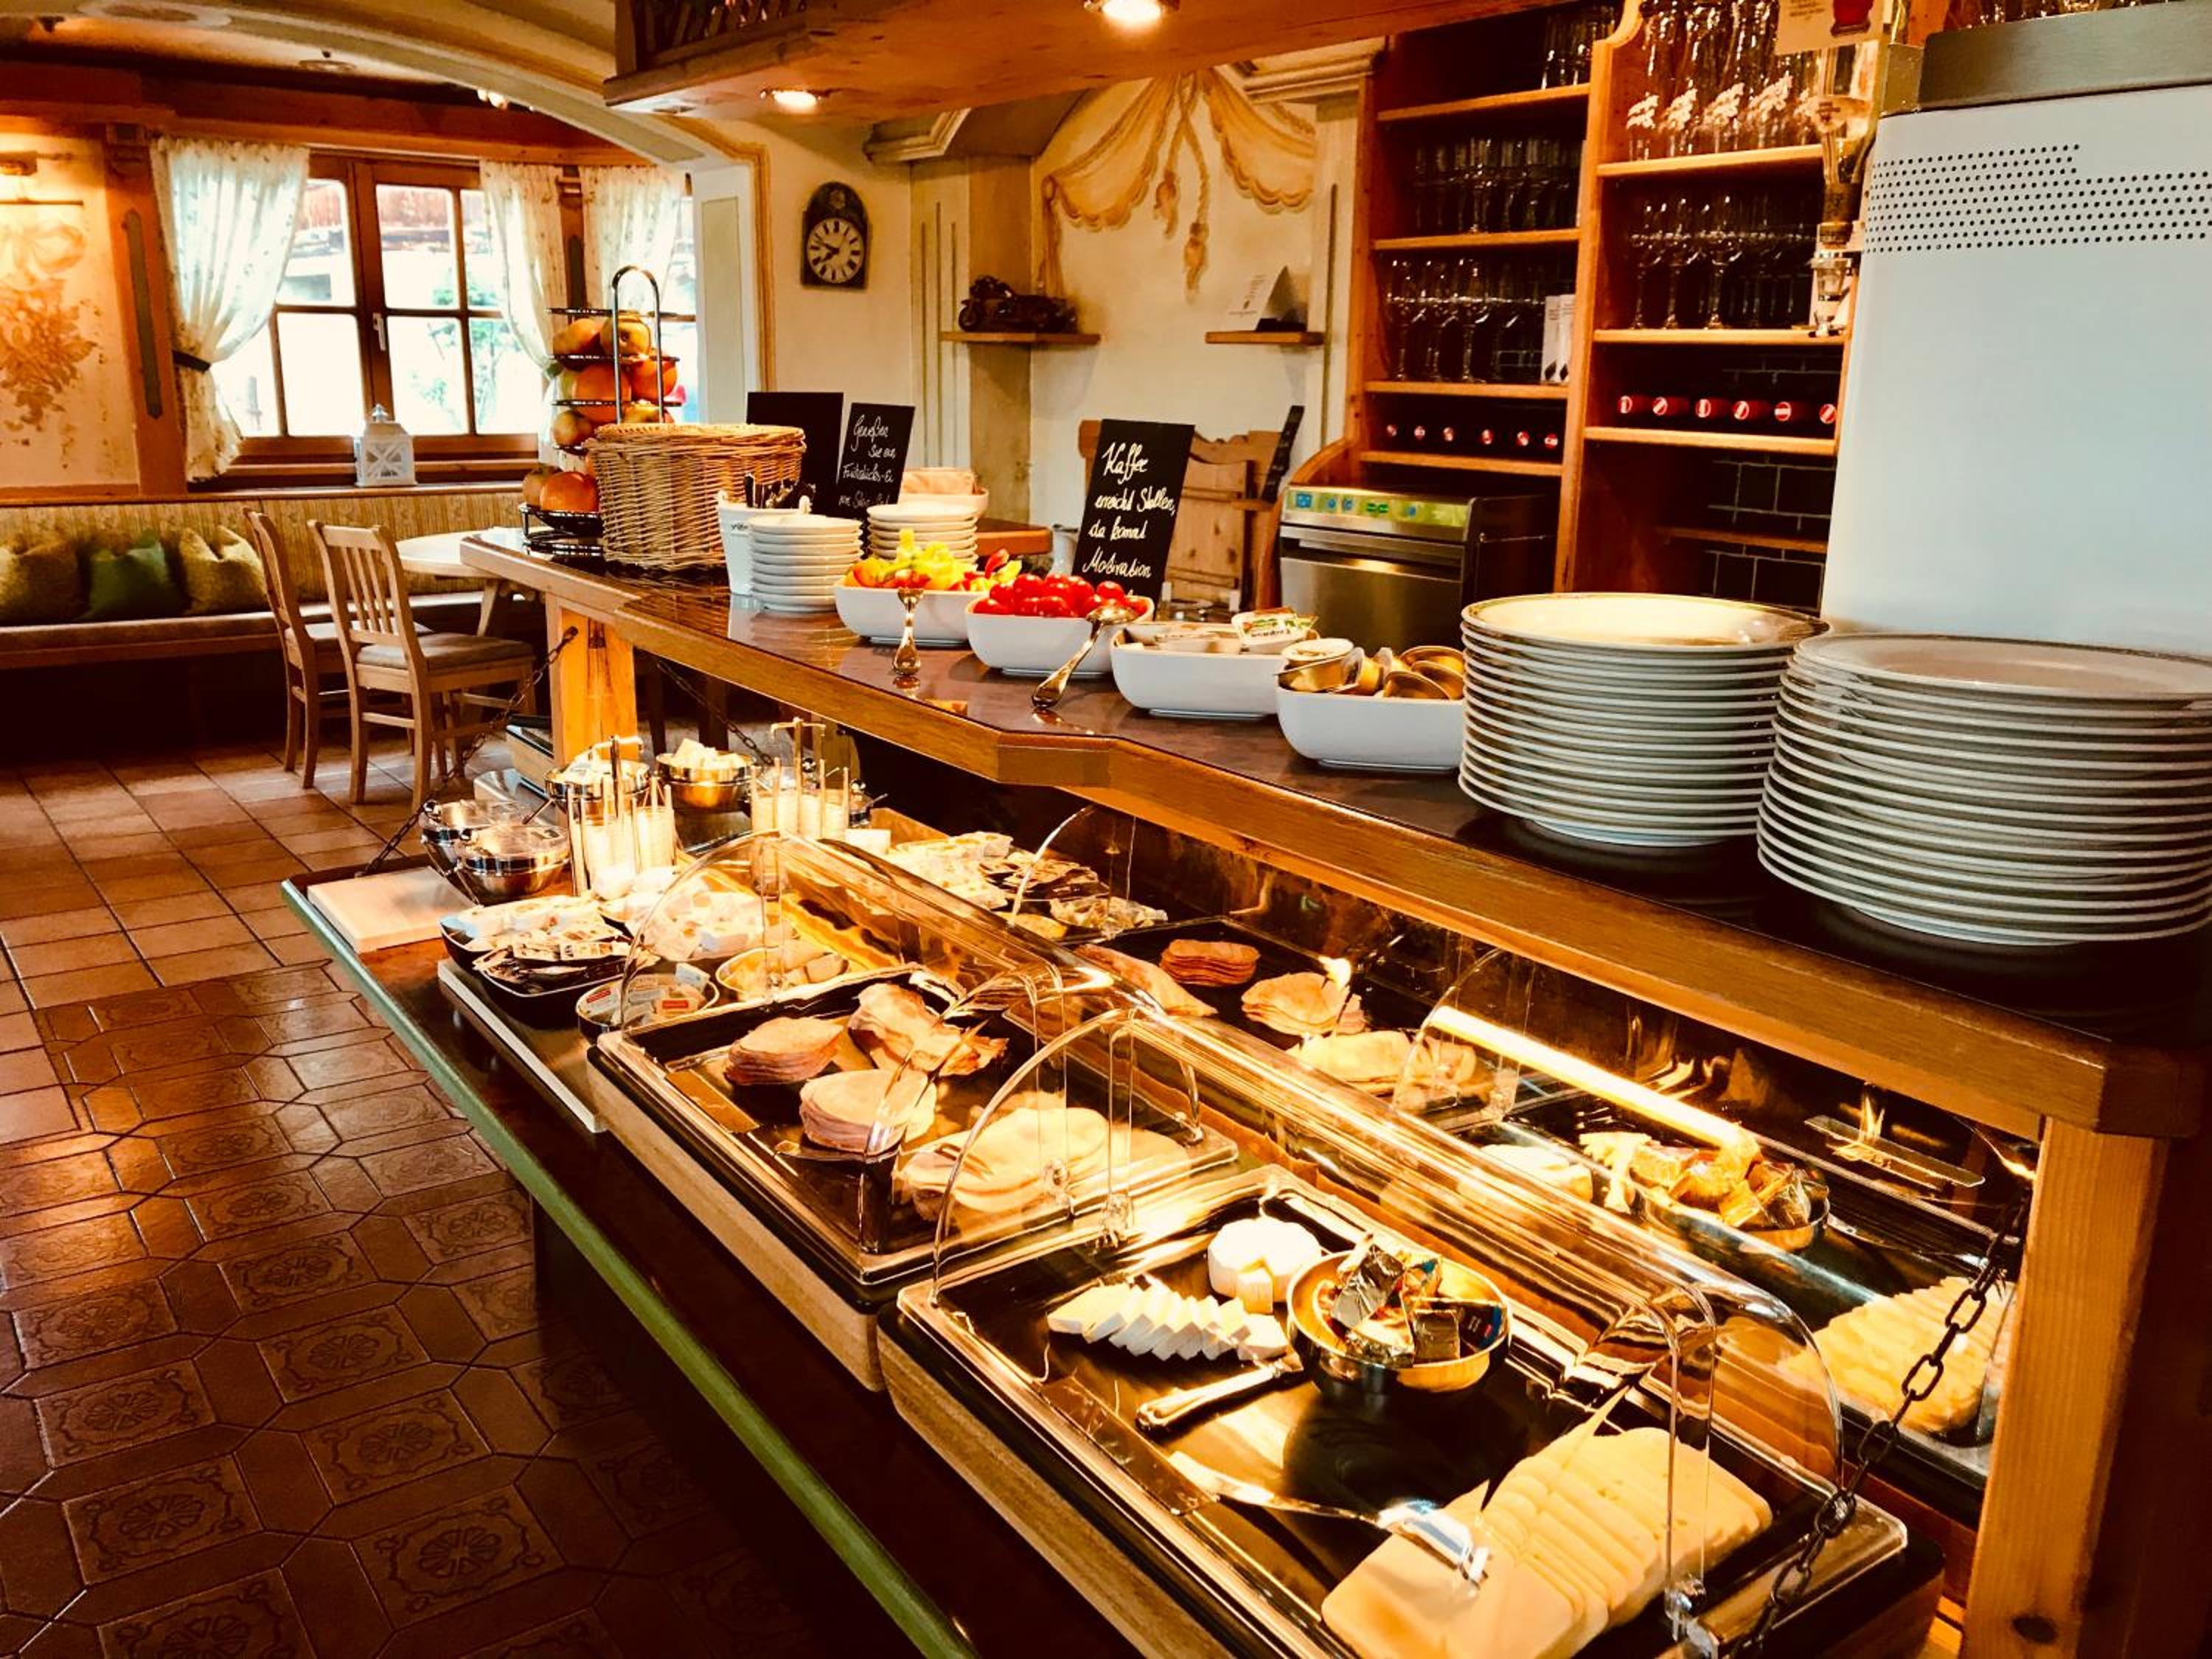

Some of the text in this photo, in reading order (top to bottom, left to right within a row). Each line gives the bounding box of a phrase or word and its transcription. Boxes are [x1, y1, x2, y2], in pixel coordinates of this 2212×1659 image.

[1102, 442, 1149, 484] Kaffee
[1088, 515, 1148, 541] da kommt
[1082, 546, 1152, 578] Motivation
